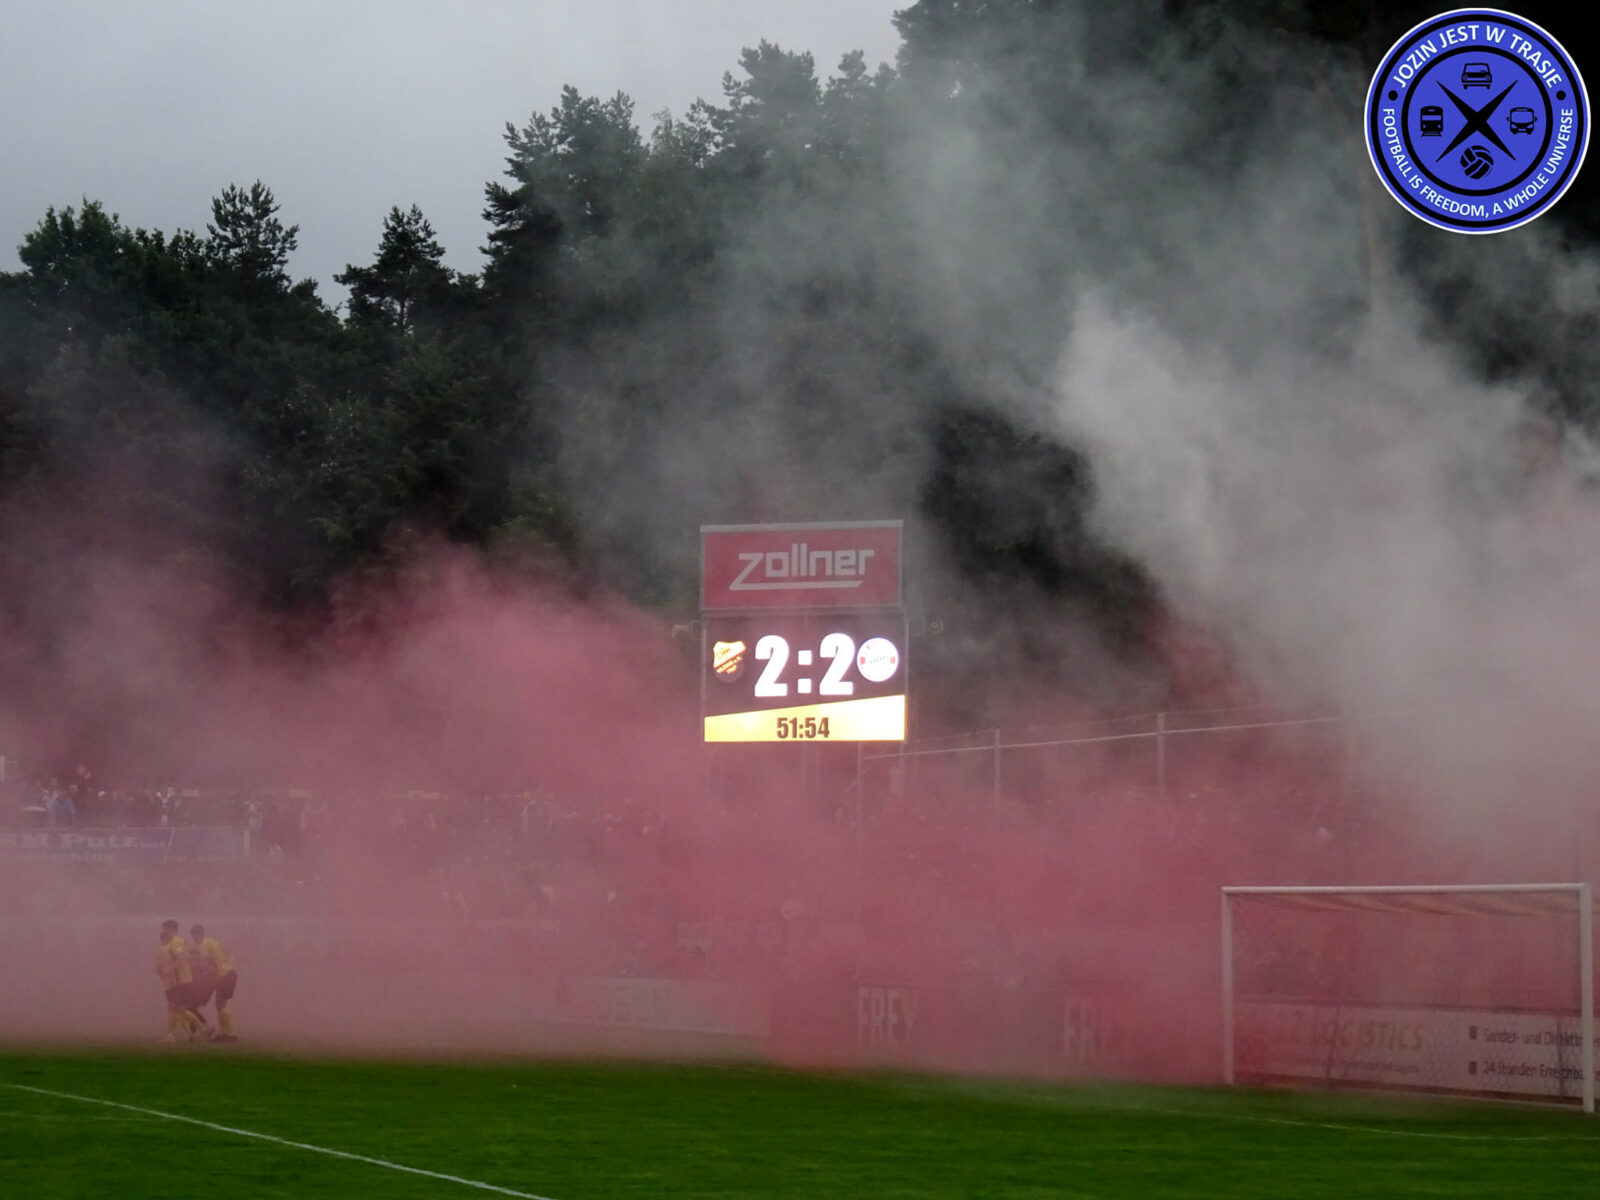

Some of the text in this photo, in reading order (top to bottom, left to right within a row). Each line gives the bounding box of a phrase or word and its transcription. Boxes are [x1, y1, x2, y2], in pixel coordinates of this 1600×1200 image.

[776, 717, 830, 739] 51:54
[60, 832, 139, 848] Putz
[1522, 1031, 1542, 1045] und
[1497, 1060, 1536, 1077] Stunden
